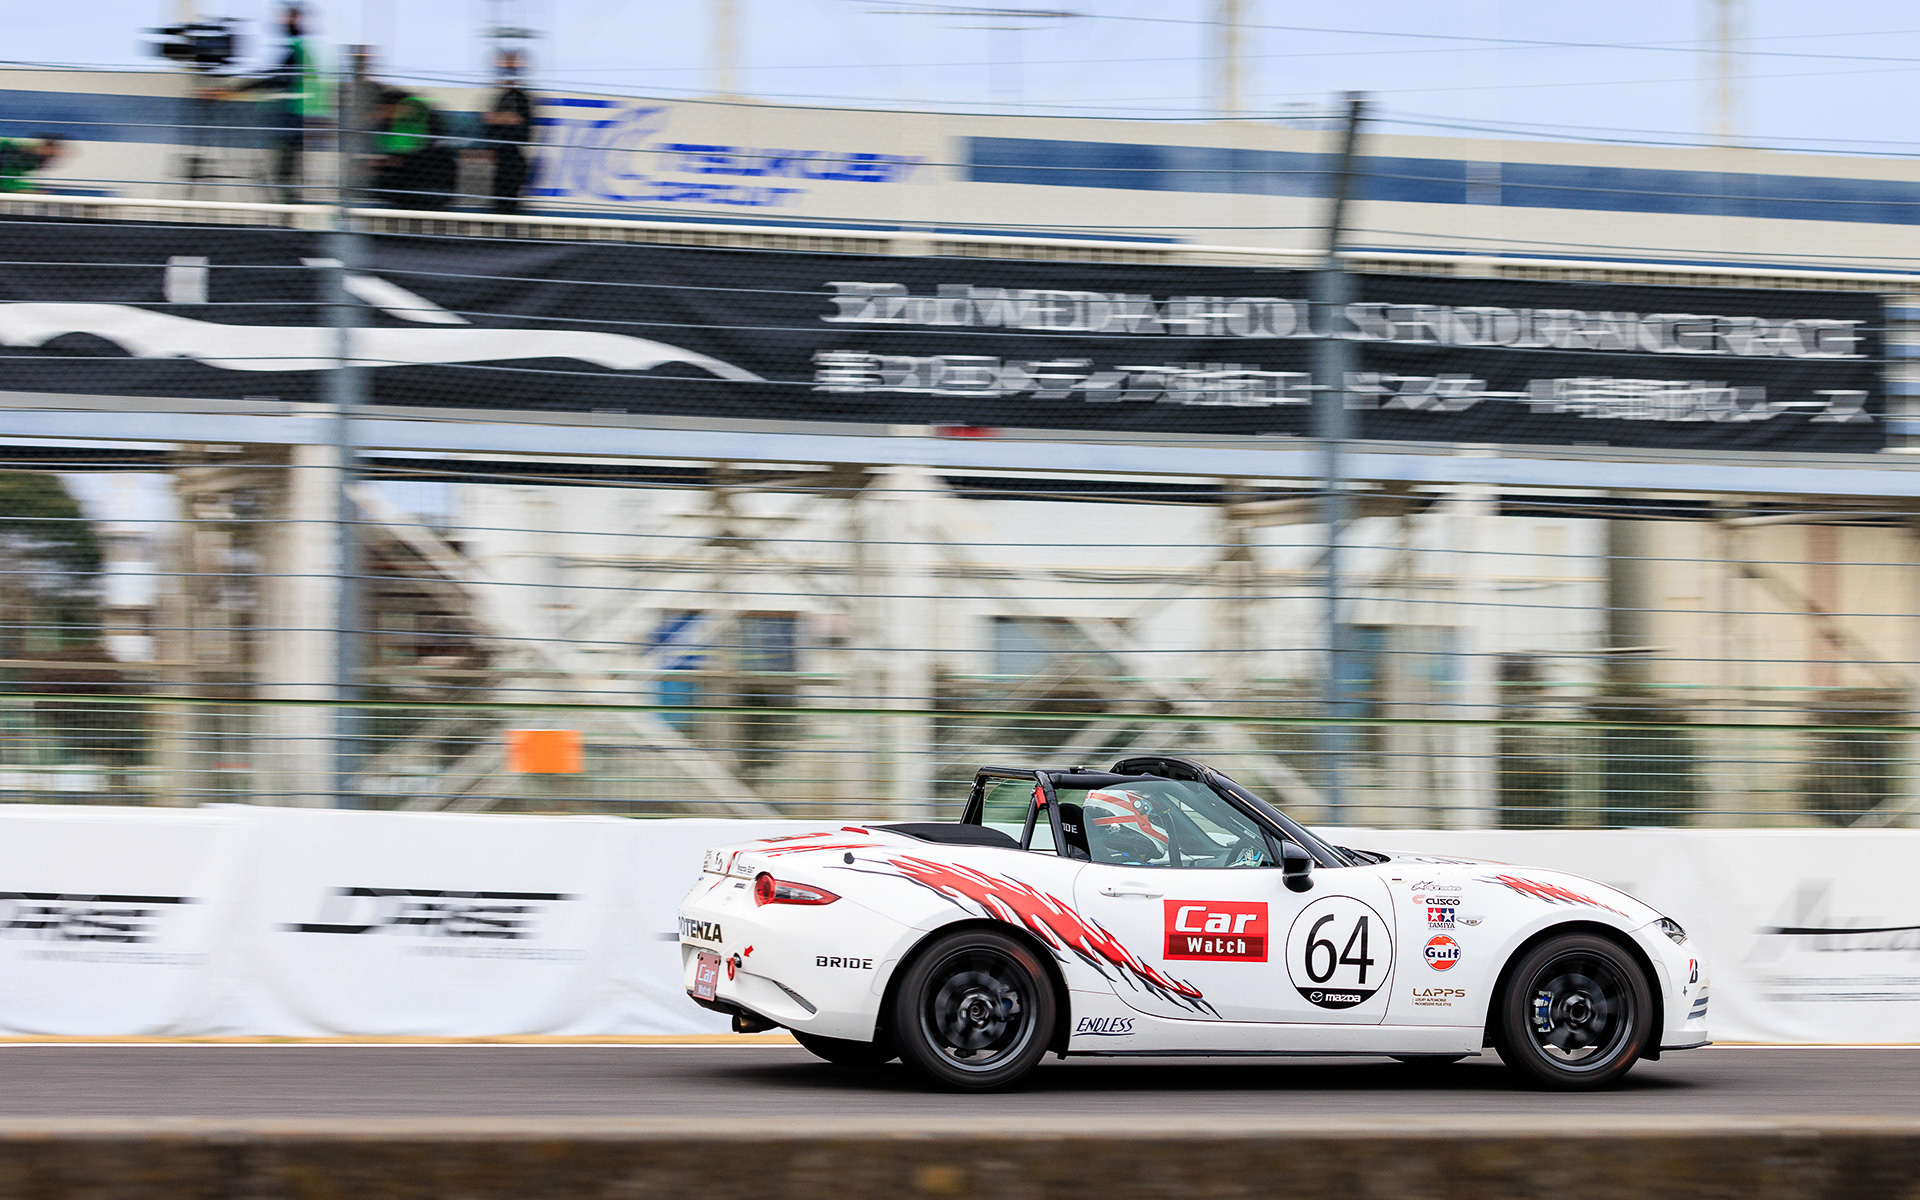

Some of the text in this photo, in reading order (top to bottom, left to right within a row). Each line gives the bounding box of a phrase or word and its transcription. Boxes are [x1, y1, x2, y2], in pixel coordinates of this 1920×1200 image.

[1175, 905, 1258, 934] Car
[1187, 937, 1246, 954] Watch
[1305, 914, 1375, 984] 64
[1425, 947, 1459, 958] Gulf
[816, 956, 873, 969] BRIDE
[698, 964, 715, 983] Car
[1413, 988, 1465, 997] LAPPS
[1075, 1017, 1135, 1032] ENDLESS
